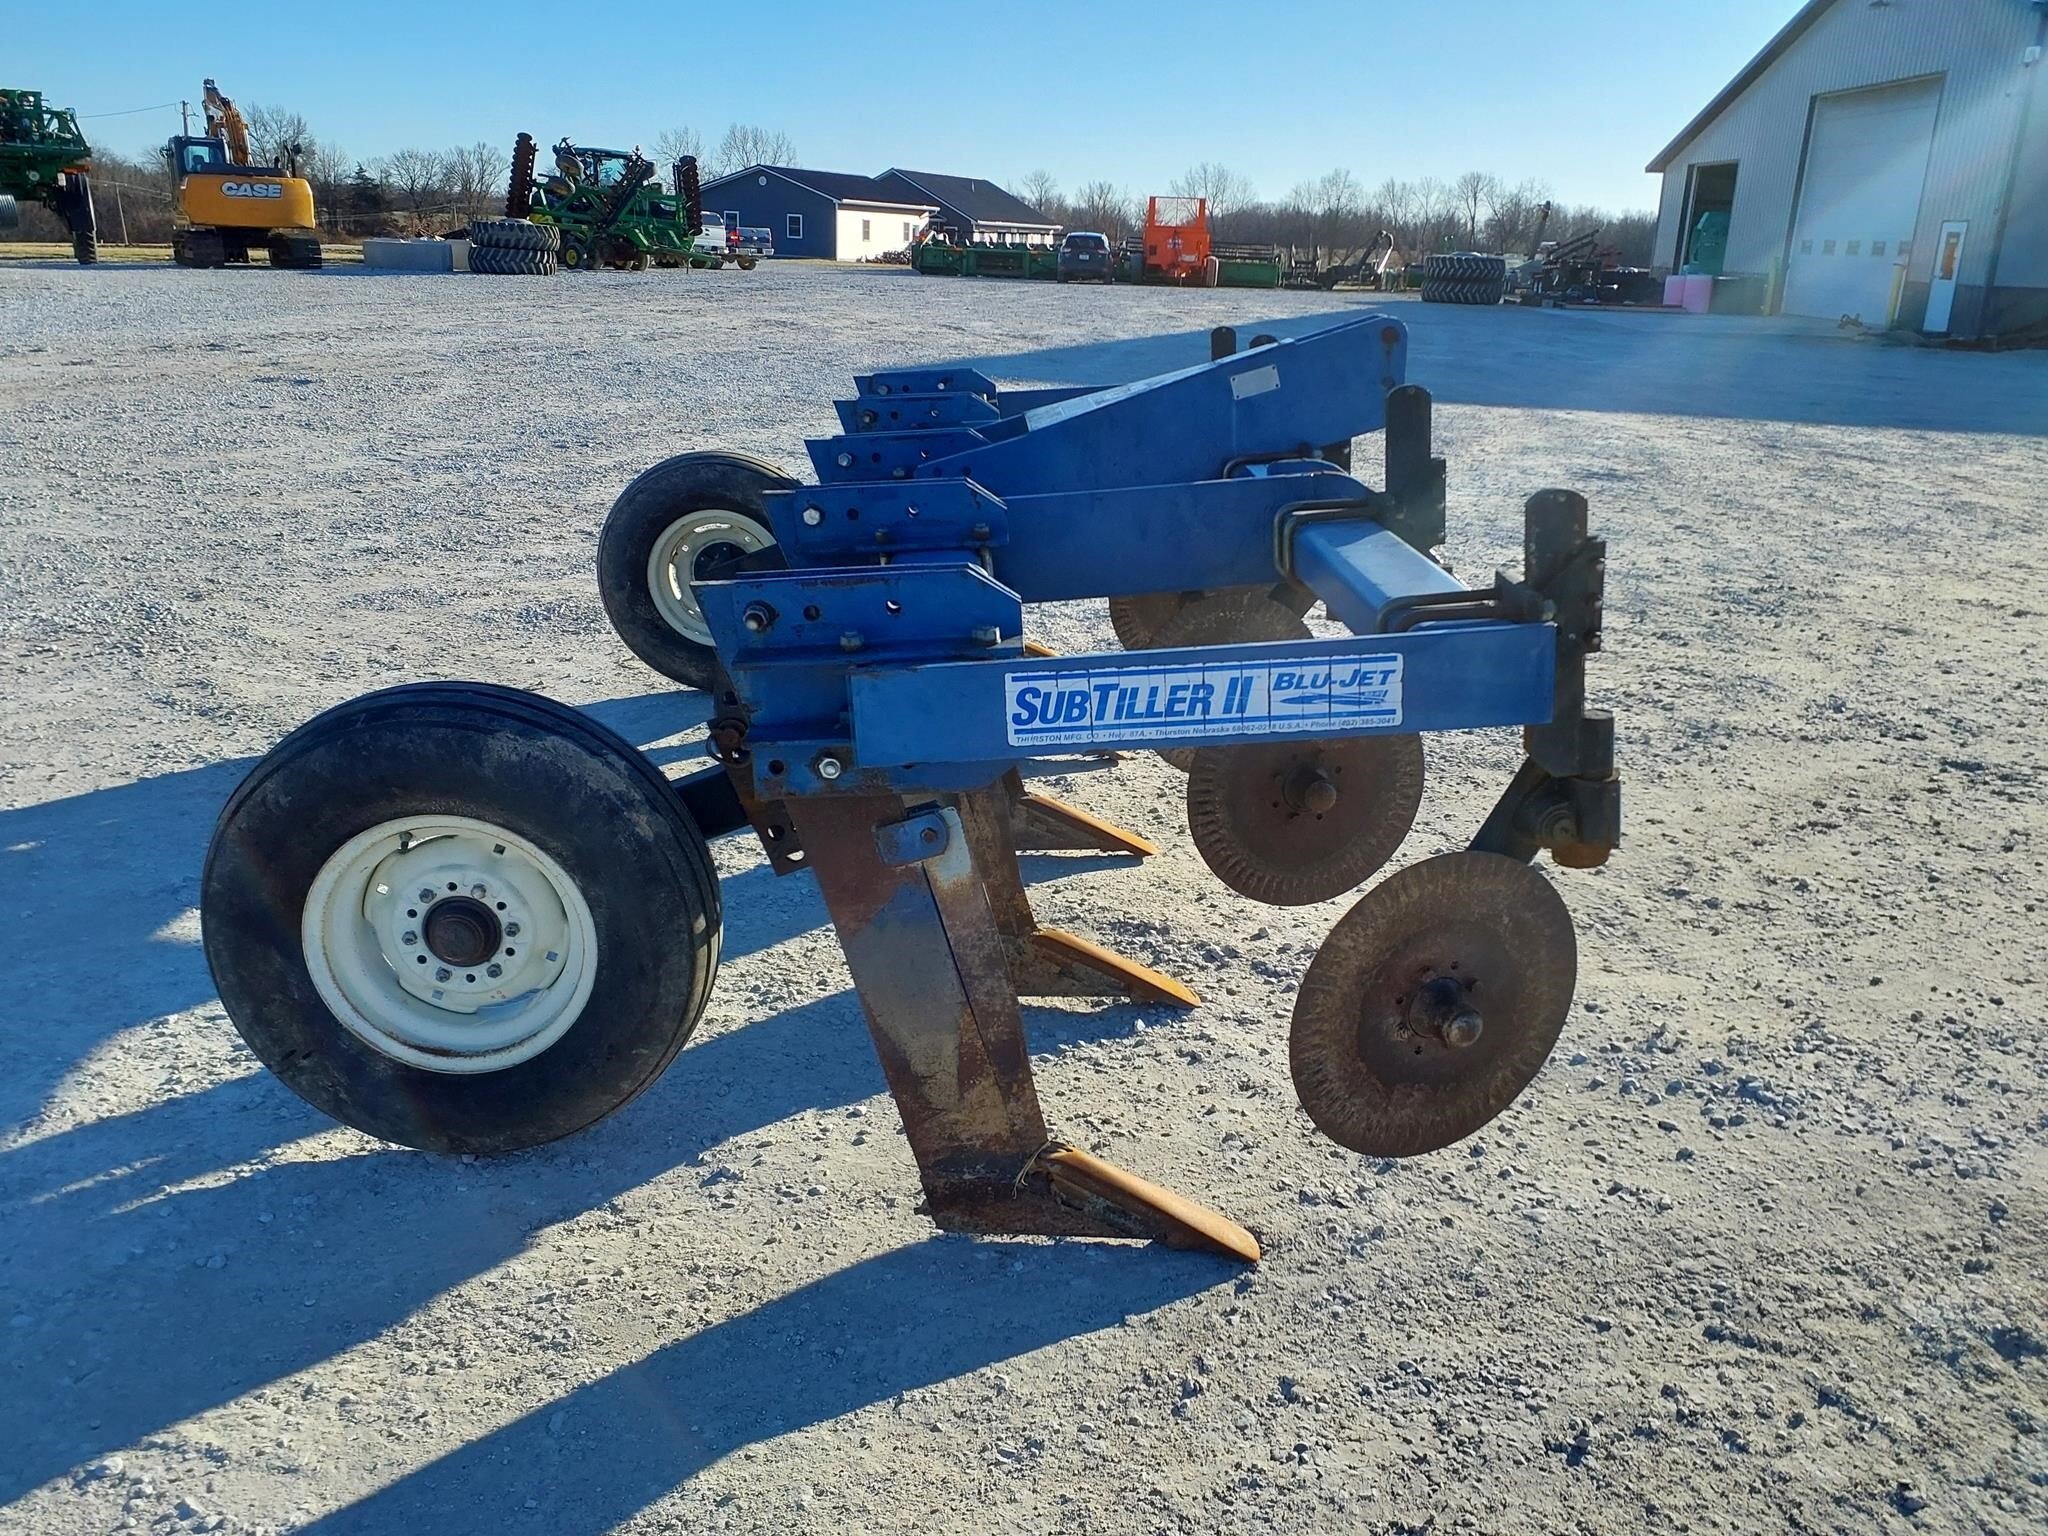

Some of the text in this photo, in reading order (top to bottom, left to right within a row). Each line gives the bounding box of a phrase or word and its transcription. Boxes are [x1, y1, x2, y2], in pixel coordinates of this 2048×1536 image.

[221, 181, 283, 198] CASE
[1272, 668, 1397, 691] BLU-JET
[1222, 676, 1254, 715] II
[1016, 733, 1062, 743] THURSTON
[1154, 728, 1190, 737] Thurston
[1192, 726, 1231, 736] Nebraska
